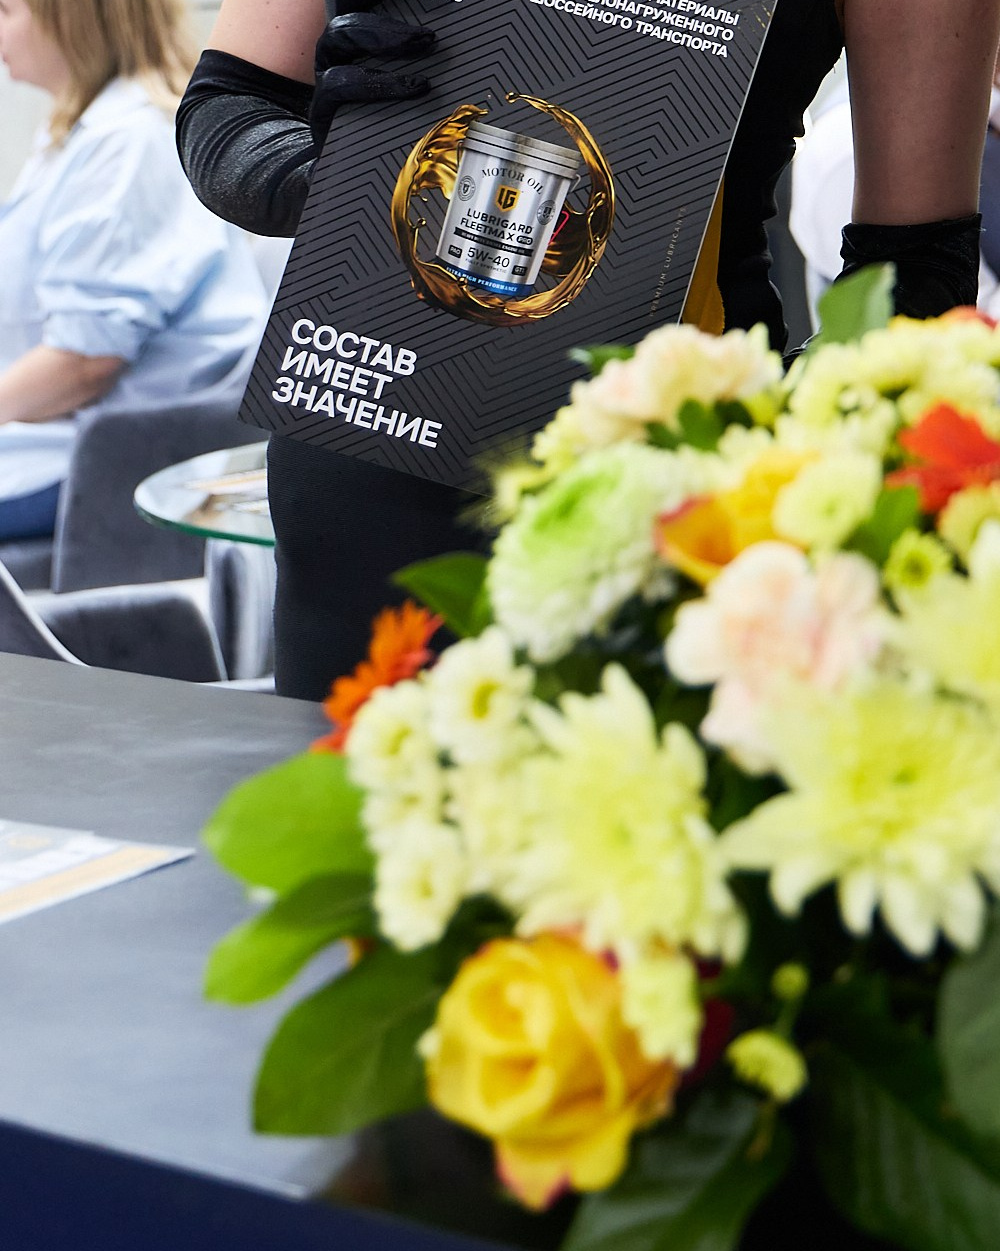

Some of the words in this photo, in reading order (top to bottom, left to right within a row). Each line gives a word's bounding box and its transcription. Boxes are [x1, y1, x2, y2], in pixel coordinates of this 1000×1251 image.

[636, 20, 728, 58] ТРАНСПОРТА
[482, 167, 525, 182] MOTOR
[527, 178, 544, 195] OIL
[460, 218, 514, 241] FLEETMAX
[467, 208, 533, 234] LUBRIGARD
[467, 248, 510, 268] 5W-40
[291, 318, 418, 376] СОСТАВ
[281, 346, 393, 399] ИМЕЕТ
[272, 377, 443, 448] ЗНАЧЕНИЕ
